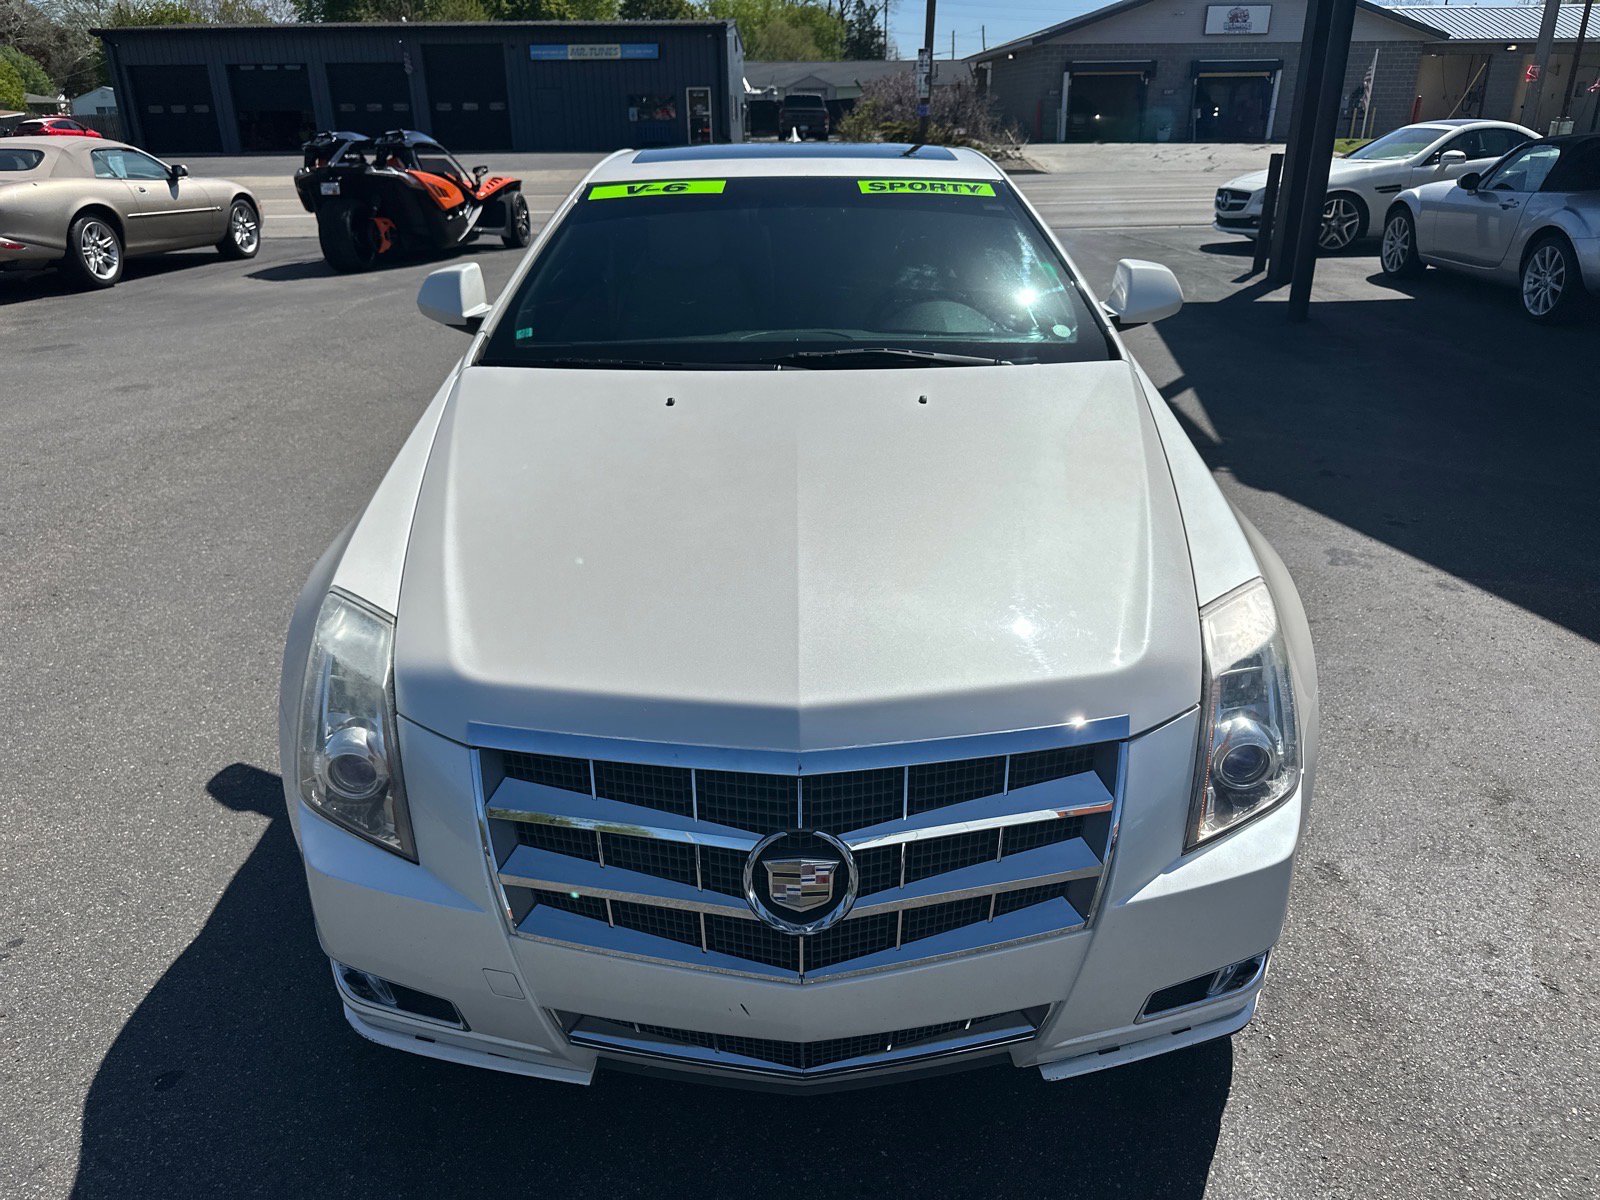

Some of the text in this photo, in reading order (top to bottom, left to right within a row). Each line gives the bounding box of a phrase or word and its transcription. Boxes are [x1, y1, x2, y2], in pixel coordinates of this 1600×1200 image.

[589, 47, 619, 56] TUNES
[627, 182, 690, 195] V-6
[868, 182, 982, 194] SPORTY
